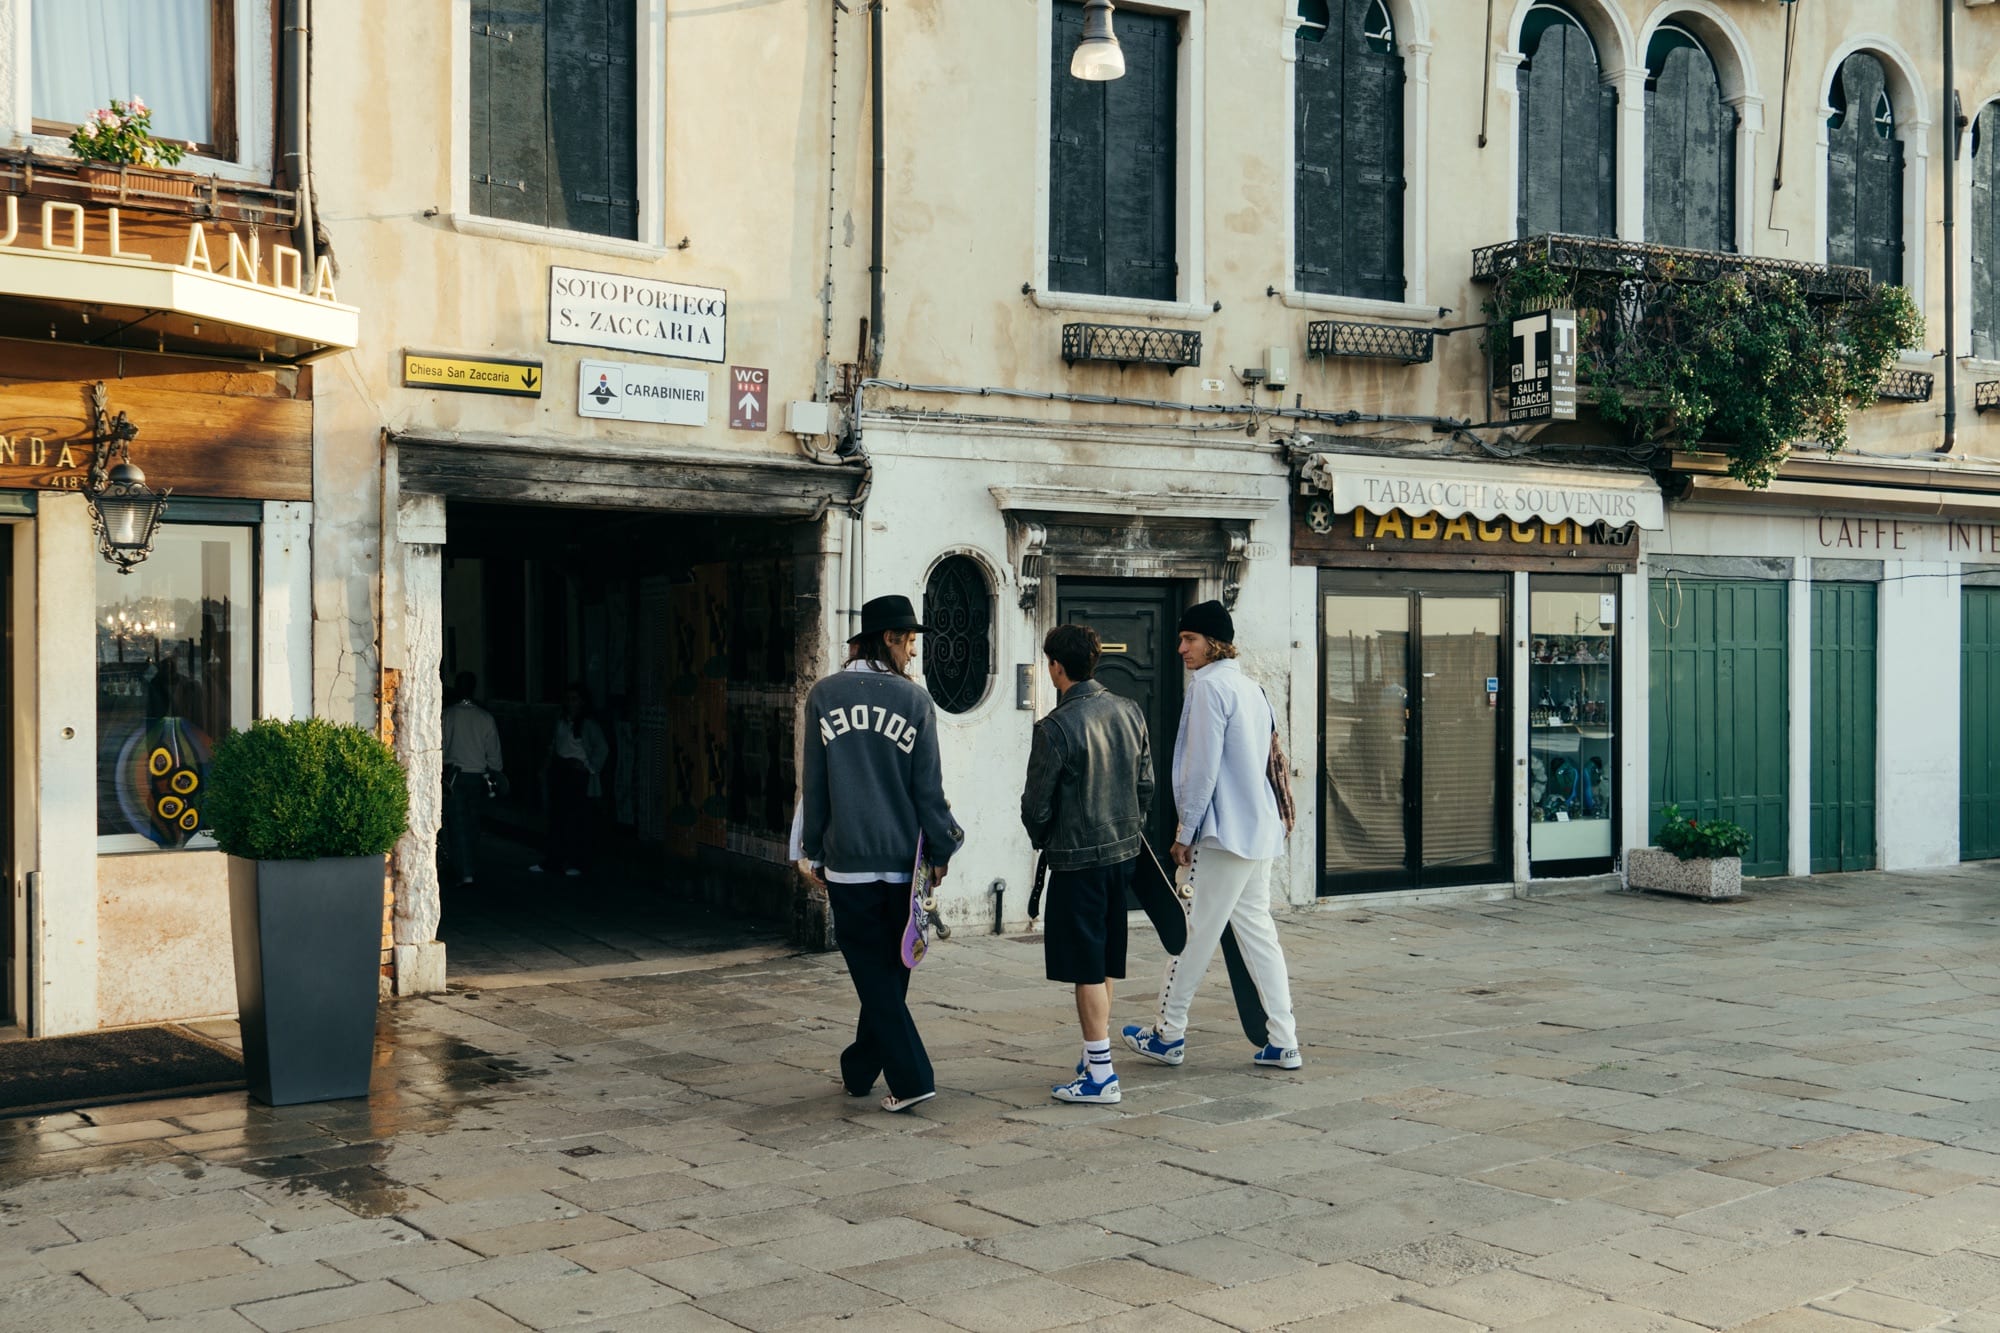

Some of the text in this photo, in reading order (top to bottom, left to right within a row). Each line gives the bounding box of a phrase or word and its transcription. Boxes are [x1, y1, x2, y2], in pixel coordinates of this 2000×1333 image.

[560, 308, 711, 344] S. ZACCARIA
[1552, 318, 1574, 352] T
[1513, 314, 1547, 380] T
[410, 363, 509, 382] Chiesa San Zaccaria
[735, 369, 764, 383] WC
[625, 383, 704, 402] CARABINIERI
[1518, 381, 1542, 394] SALI E
[1512, 392, 1549, 407] TABACCHI
[1511, 405, 1550, 420] VALORI BOLLATI
[1364, 478, 1636, 517] TABACCHI & SOUVENIRS
